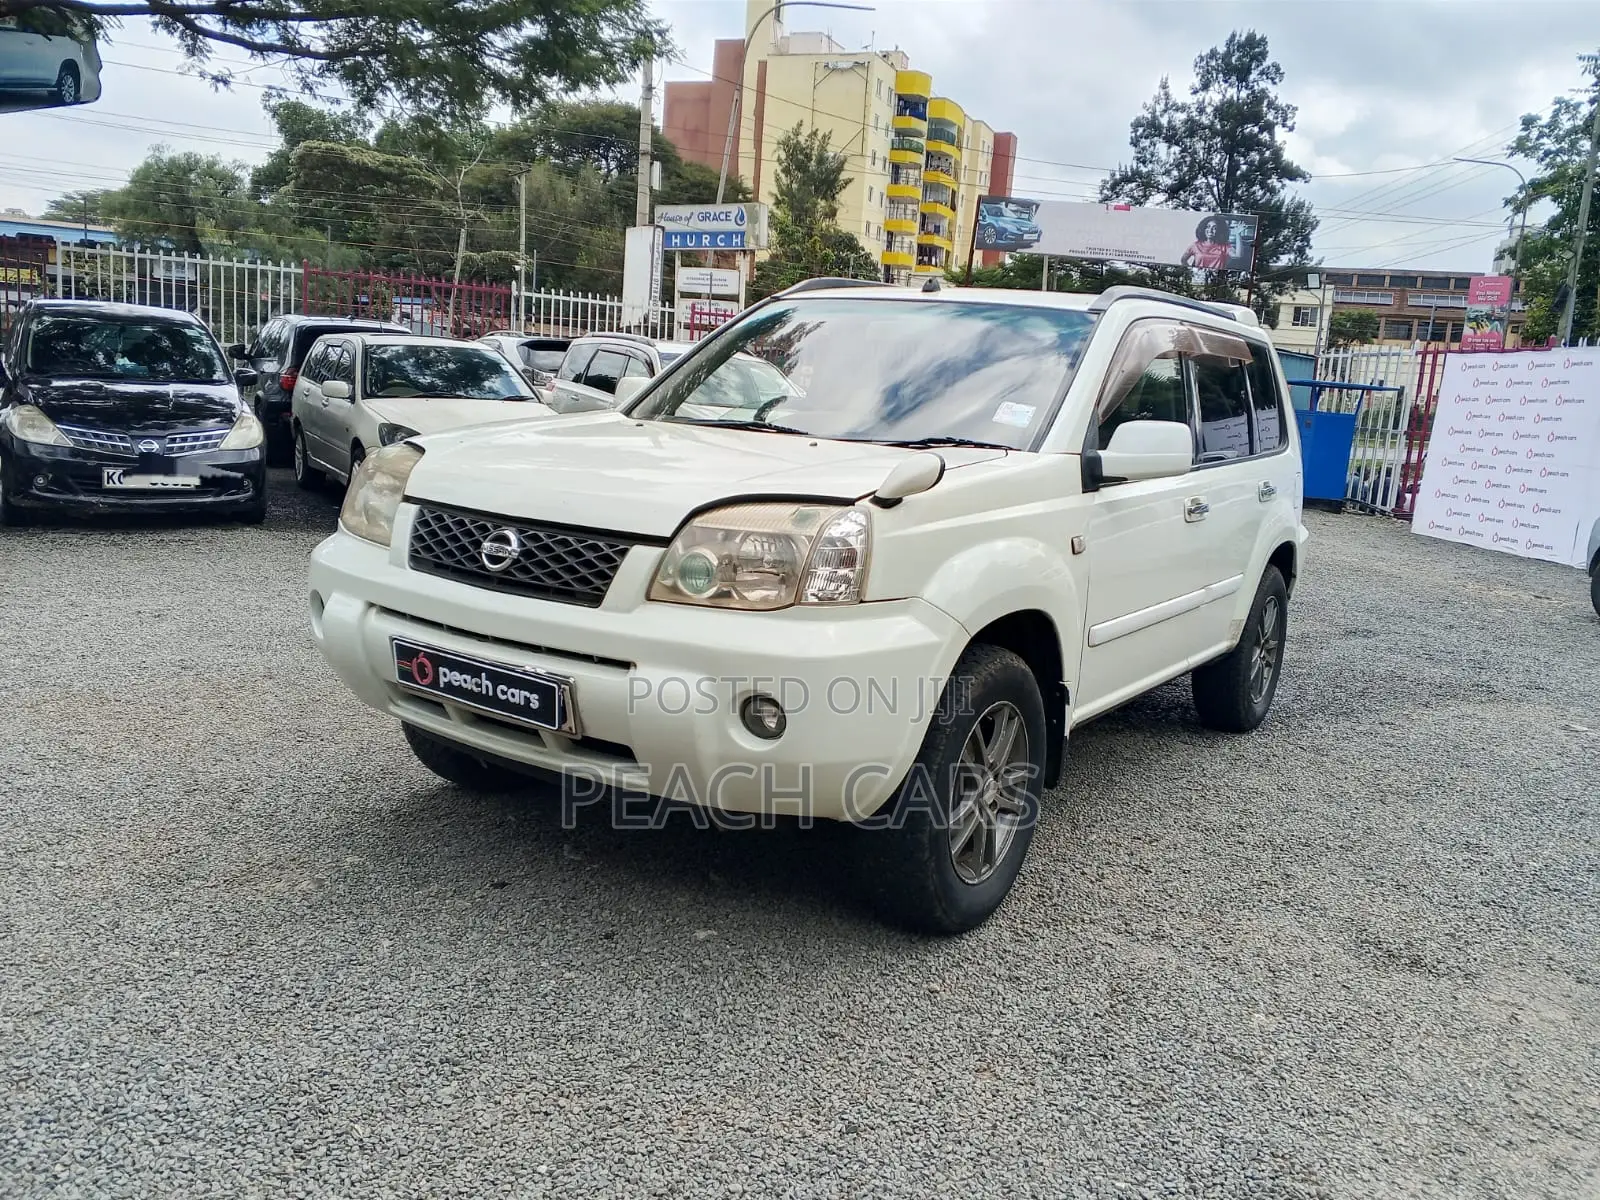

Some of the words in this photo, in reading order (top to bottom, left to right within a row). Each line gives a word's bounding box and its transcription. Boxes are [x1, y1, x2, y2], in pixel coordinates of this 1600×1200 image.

[657, 212, 683, 223] House
[684, 212, 693, 226] of
[697, 211, 732, 222] GRACE
[671, 233, 741, 247] HURCH
[439, 665, 493, 696] peach
[496, 682, 540, 710] cars
